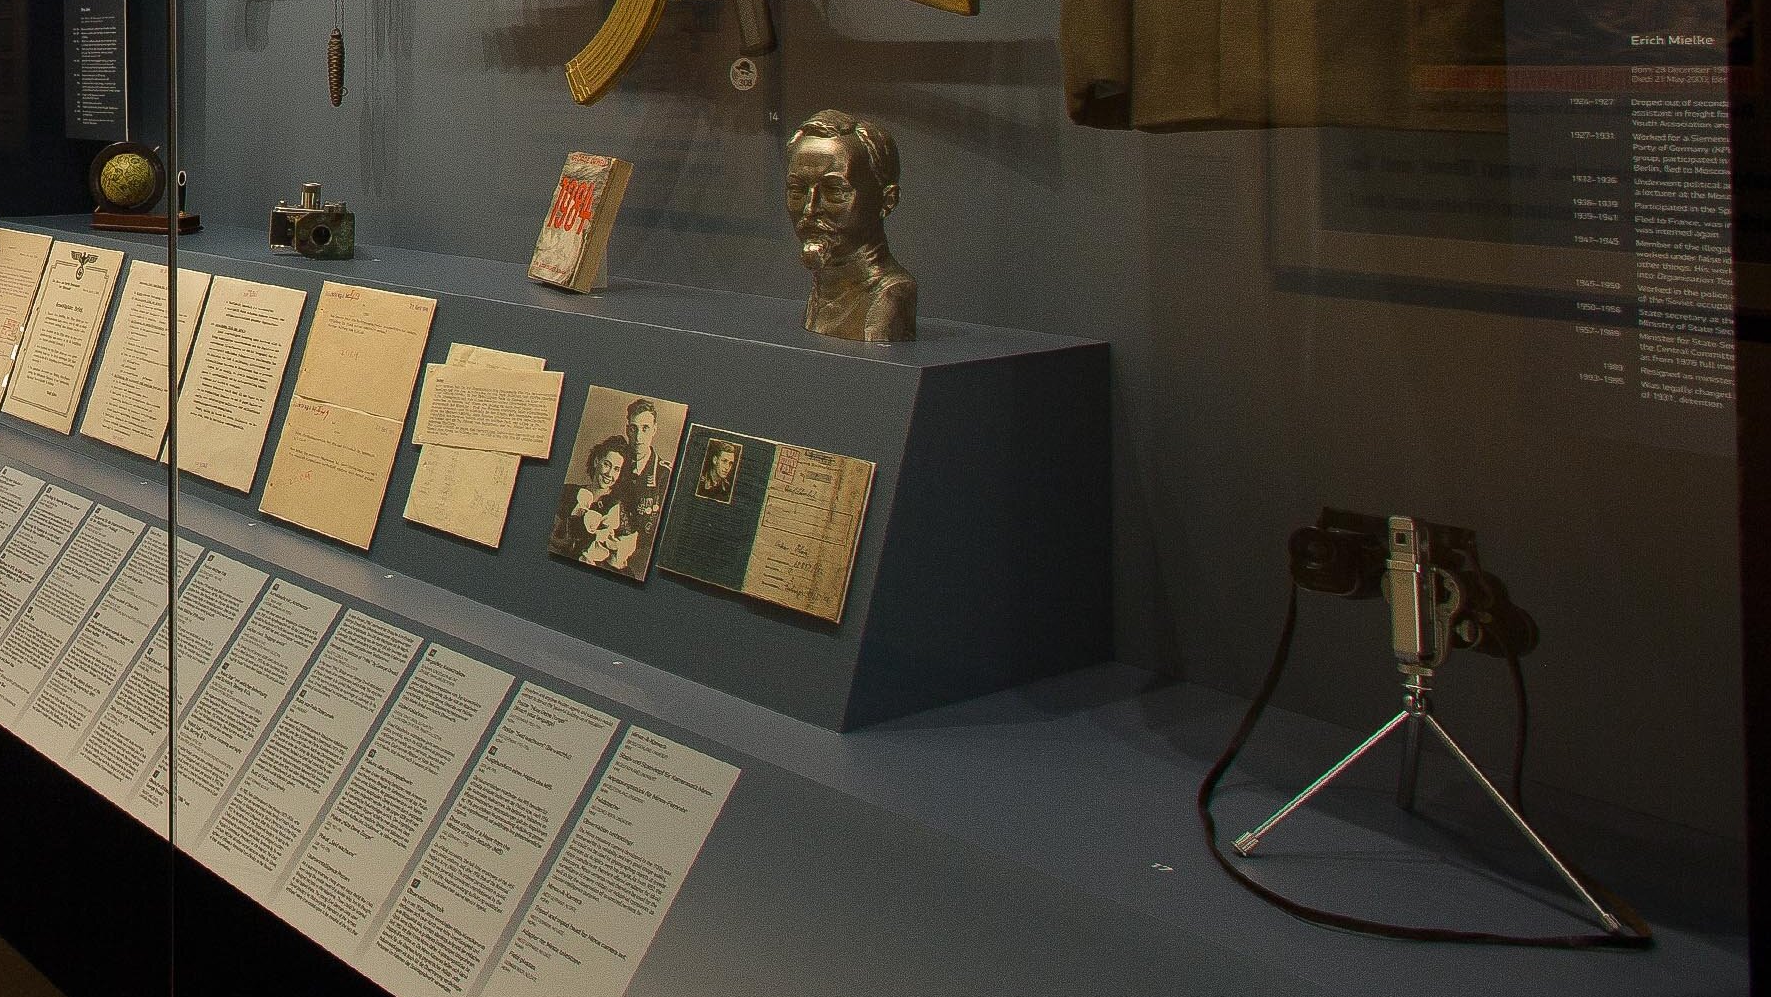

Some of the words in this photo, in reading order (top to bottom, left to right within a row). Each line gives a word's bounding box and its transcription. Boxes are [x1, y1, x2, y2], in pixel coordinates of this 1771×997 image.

[1630, 36, 1665, 45] Erich
[1668, 36, 1716, 45] Mielke
[768, 111, 779, 122] 14
[547, 174, 596, 235] 1984
